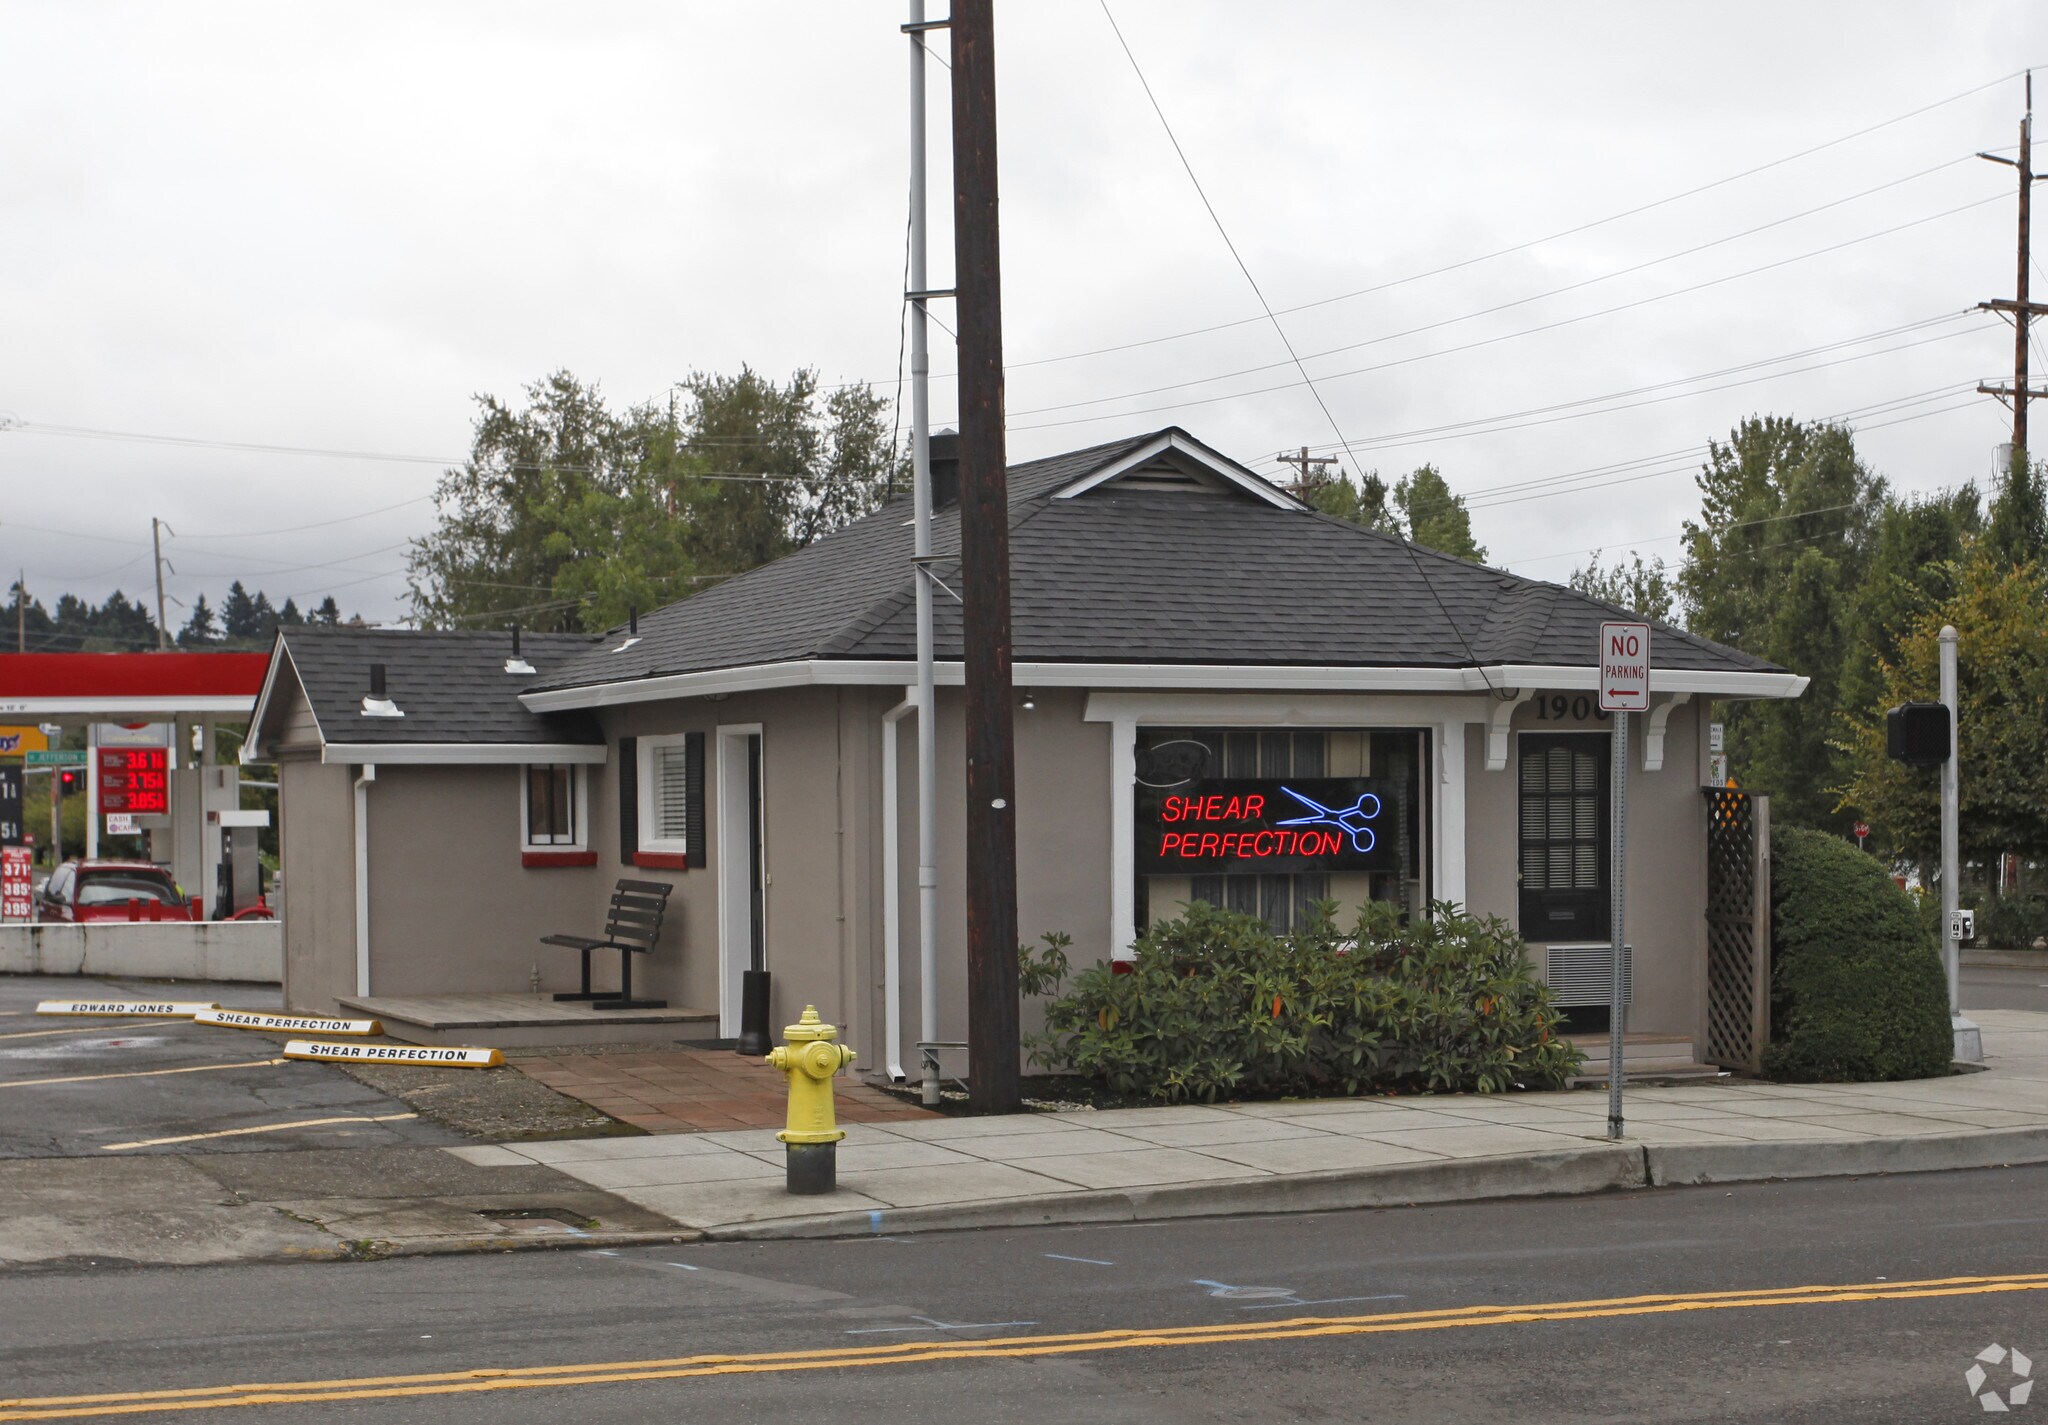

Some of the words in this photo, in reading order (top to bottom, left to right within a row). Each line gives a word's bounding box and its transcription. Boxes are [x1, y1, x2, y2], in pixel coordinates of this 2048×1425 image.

[1611, 635, 1639, 657] NO
[1605, 665, 1644, 679] PARKING
[39, 753, 78, 761] JEFFERSON
[1161, 794, 1265, 823] SHEAR
[1160, 830, 1343, 859] PERFECTION
[71, 1003, 125, 1013] EDWARD
[130, 1004, 175, 1013] JONES
[216, 1013, 261, 1026] SHEAR
[265, 1018, 352, 1031] PERFECTION
[309, 1045, 361, 1057] SHEAR
[367, 1048, 468, 1061] PERFECTION
